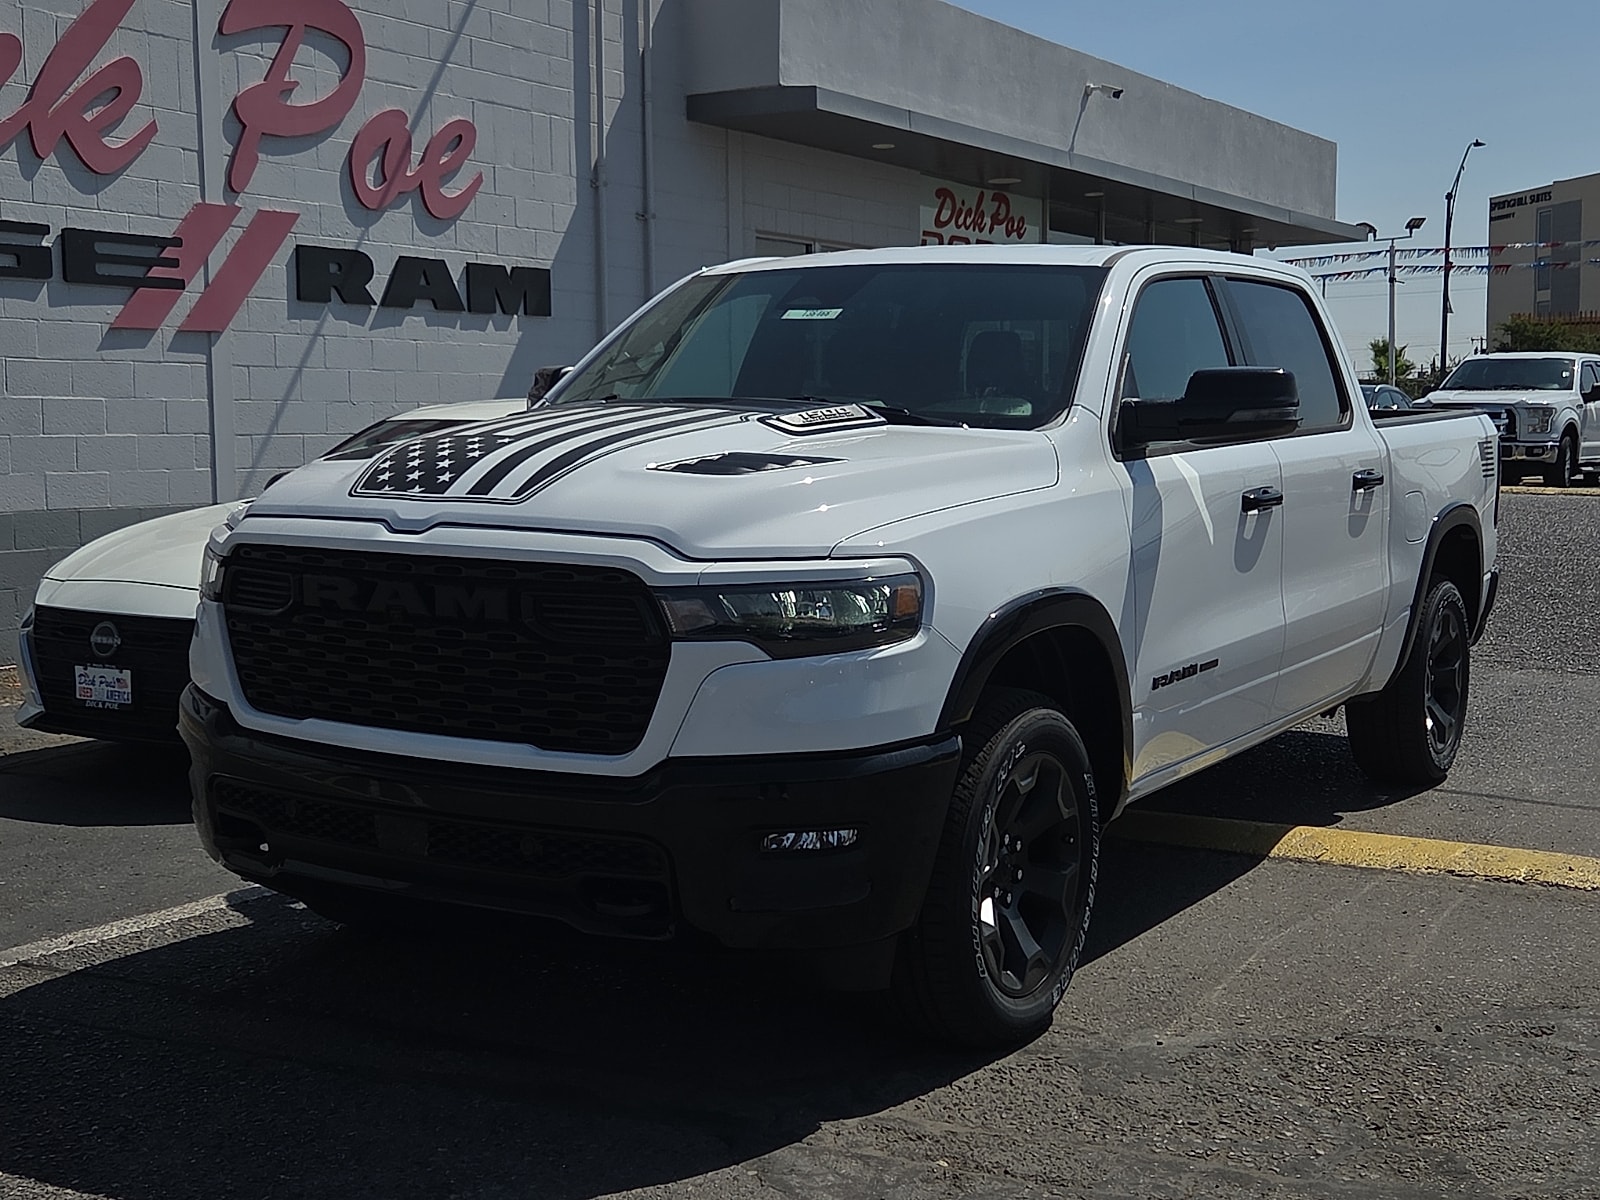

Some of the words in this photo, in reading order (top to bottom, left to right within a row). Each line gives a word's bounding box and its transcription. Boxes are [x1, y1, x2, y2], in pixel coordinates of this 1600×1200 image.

[219, 0, 483, 220] Poe
[934, 187, 986, 234] Dick
[988, 191, 1027, 240] Poe
[1529, 191, 1552, 205] SUITES
[296, 244, 551, 317] RAM
[302, 574, 509, 622] RAM
[1152, 663, 1198, 691] RAM
[104, 701, 120, 710] POE
